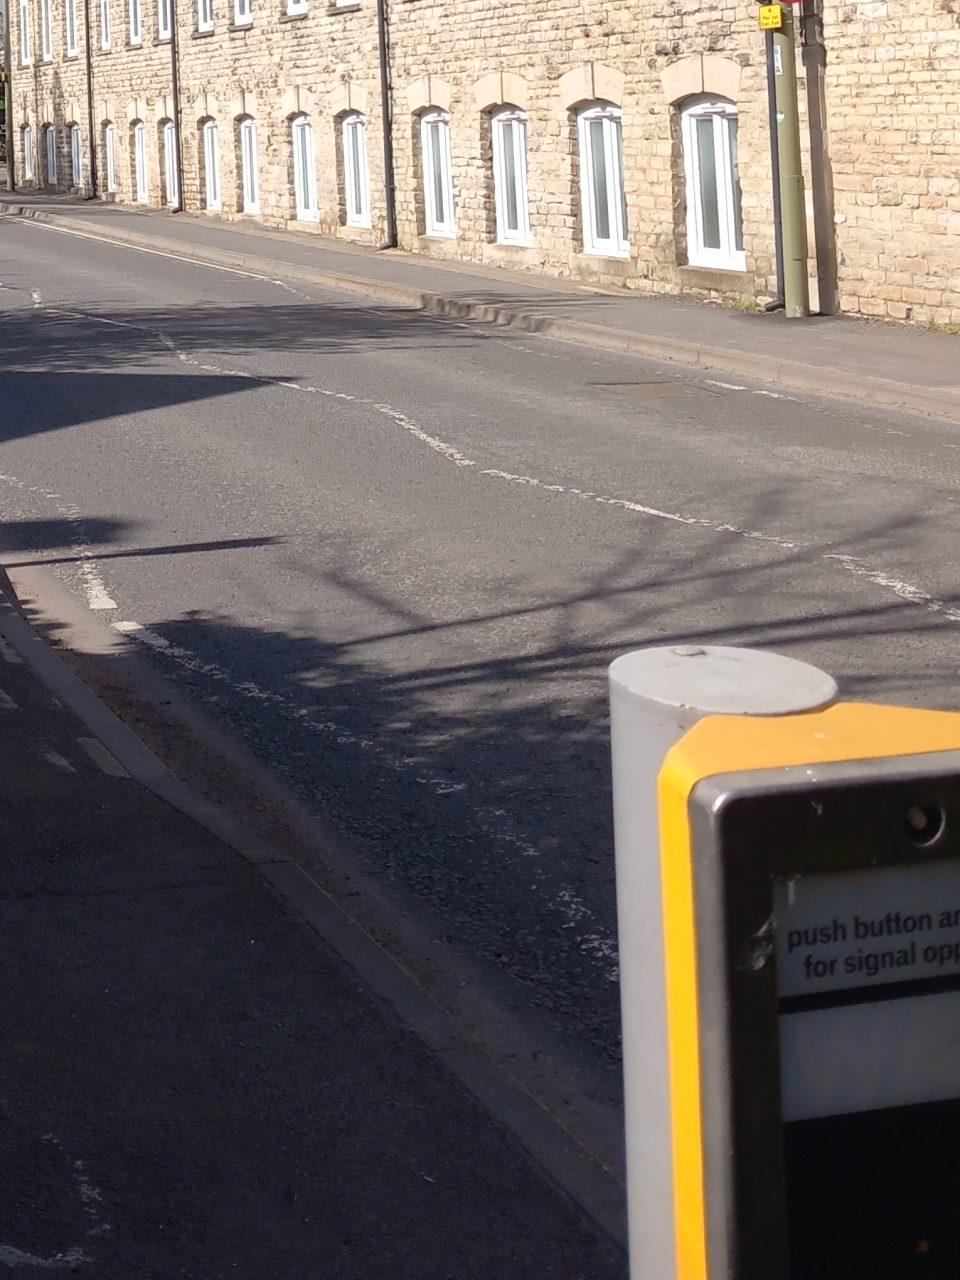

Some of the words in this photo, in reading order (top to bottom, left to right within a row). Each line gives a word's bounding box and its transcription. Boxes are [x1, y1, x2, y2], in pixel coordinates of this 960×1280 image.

[787, 918, 848, 954] push
[853, 911, 932, 941] button
[803, 954, 838, 980] for
[844, 941, 916, 977] signal
